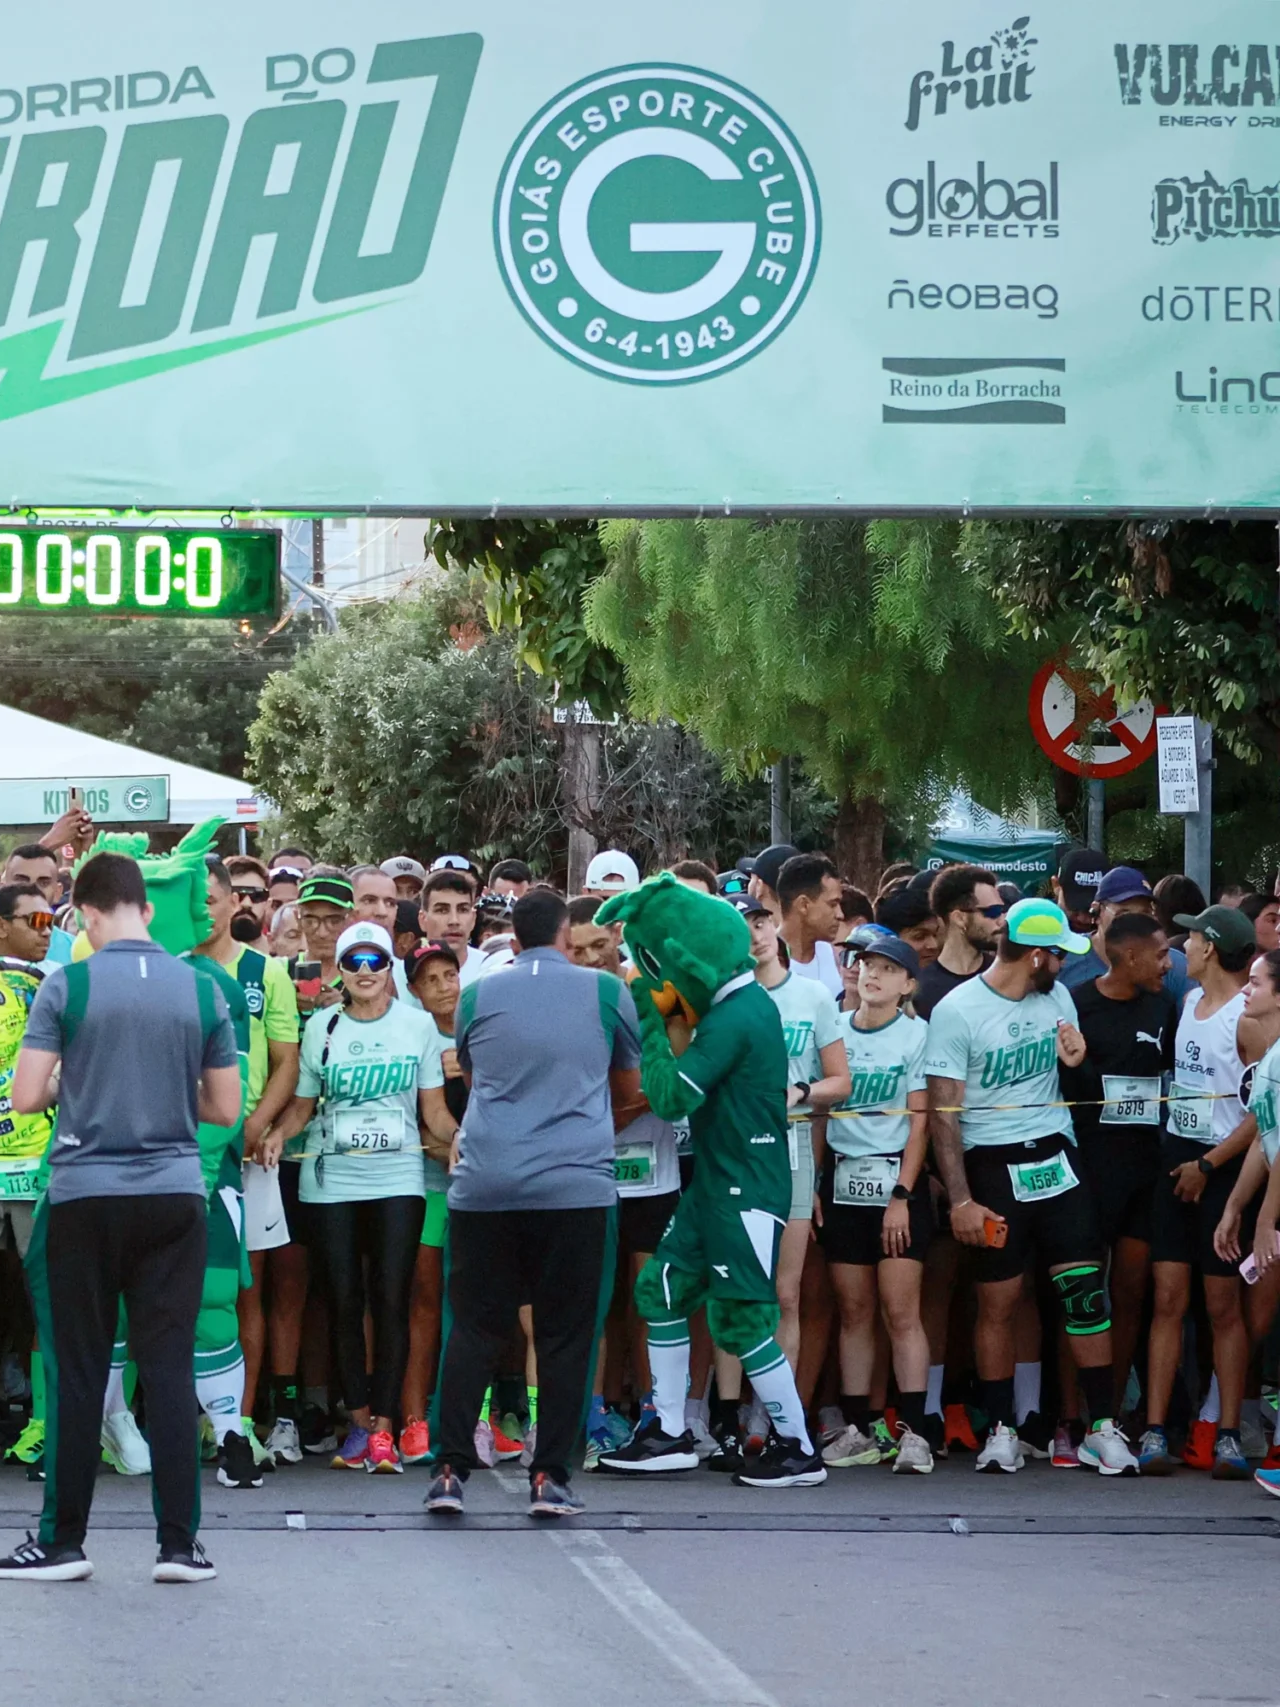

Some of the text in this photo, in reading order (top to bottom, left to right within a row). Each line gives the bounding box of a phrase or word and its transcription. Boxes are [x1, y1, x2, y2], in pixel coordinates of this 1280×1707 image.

[266, 47, 357, 91] DO
[941, 40, 994, 77] La
[1114, 44, 1280, 107] VULCA
[903, 63, 1036, 132] fruit
[1159, 115, 1238, 128] ENERGY
[519, 89, 795, 286] GOIÁS ESPORTE CLUBE
[886, 160, 1060, 237] global
[1154, 184, 1280, 239] Pitchu
[928, 224, 1060, 238] EFFECTS
[584, 315, 736, 360] 6-4-1943
[889, 378, 1062, 398] Reino da Borracha
[81, 787, 110, 814] ÓS
[351, 1132, 389, 1149] 5276
[613, 1164, 640, 1181] 278
[1030, 1171, 1060, 1191] 1569
[848, 1180, 884, 1198] 6294
